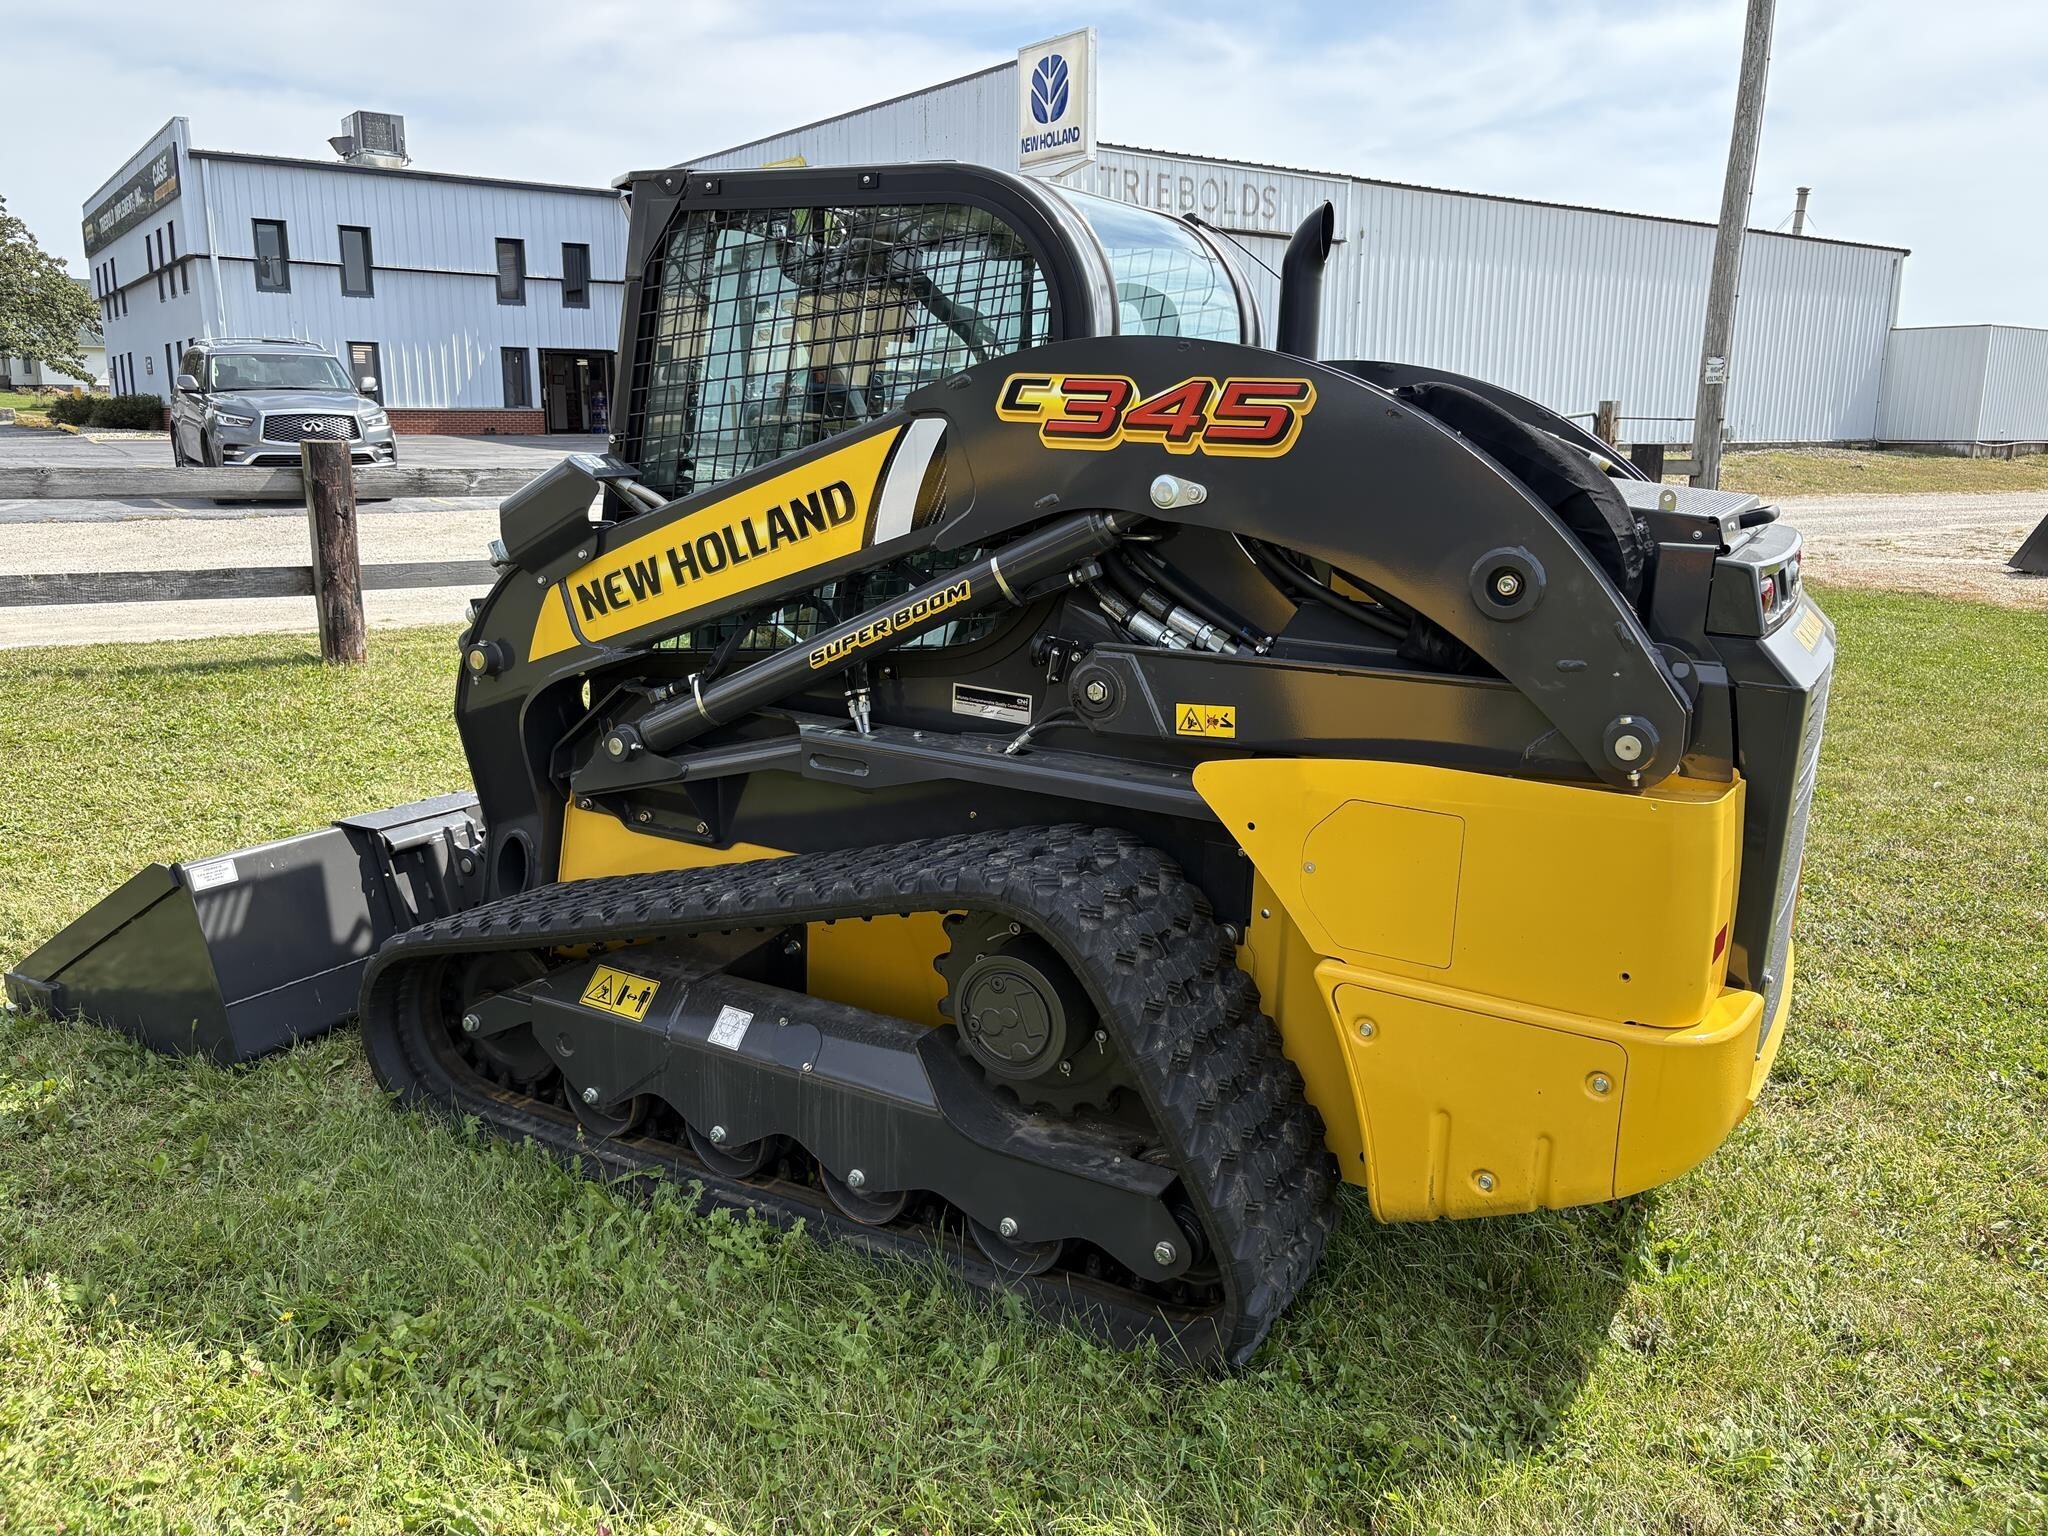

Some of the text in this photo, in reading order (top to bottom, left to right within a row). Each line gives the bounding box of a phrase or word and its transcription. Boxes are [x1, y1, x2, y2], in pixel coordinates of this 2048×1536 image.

[1021, 126, 1080, 154] NEW HOLLAND
[152, 155, 168, 187] CASE
[1100, 166, 1276, 219] TRIEBOLDS
[1706, 375, 1723, 383] VOLTAGE
[576, 480, 858, 623] NEW HOLLAND
[810, 579, 971, 669] SUPER BOOM
